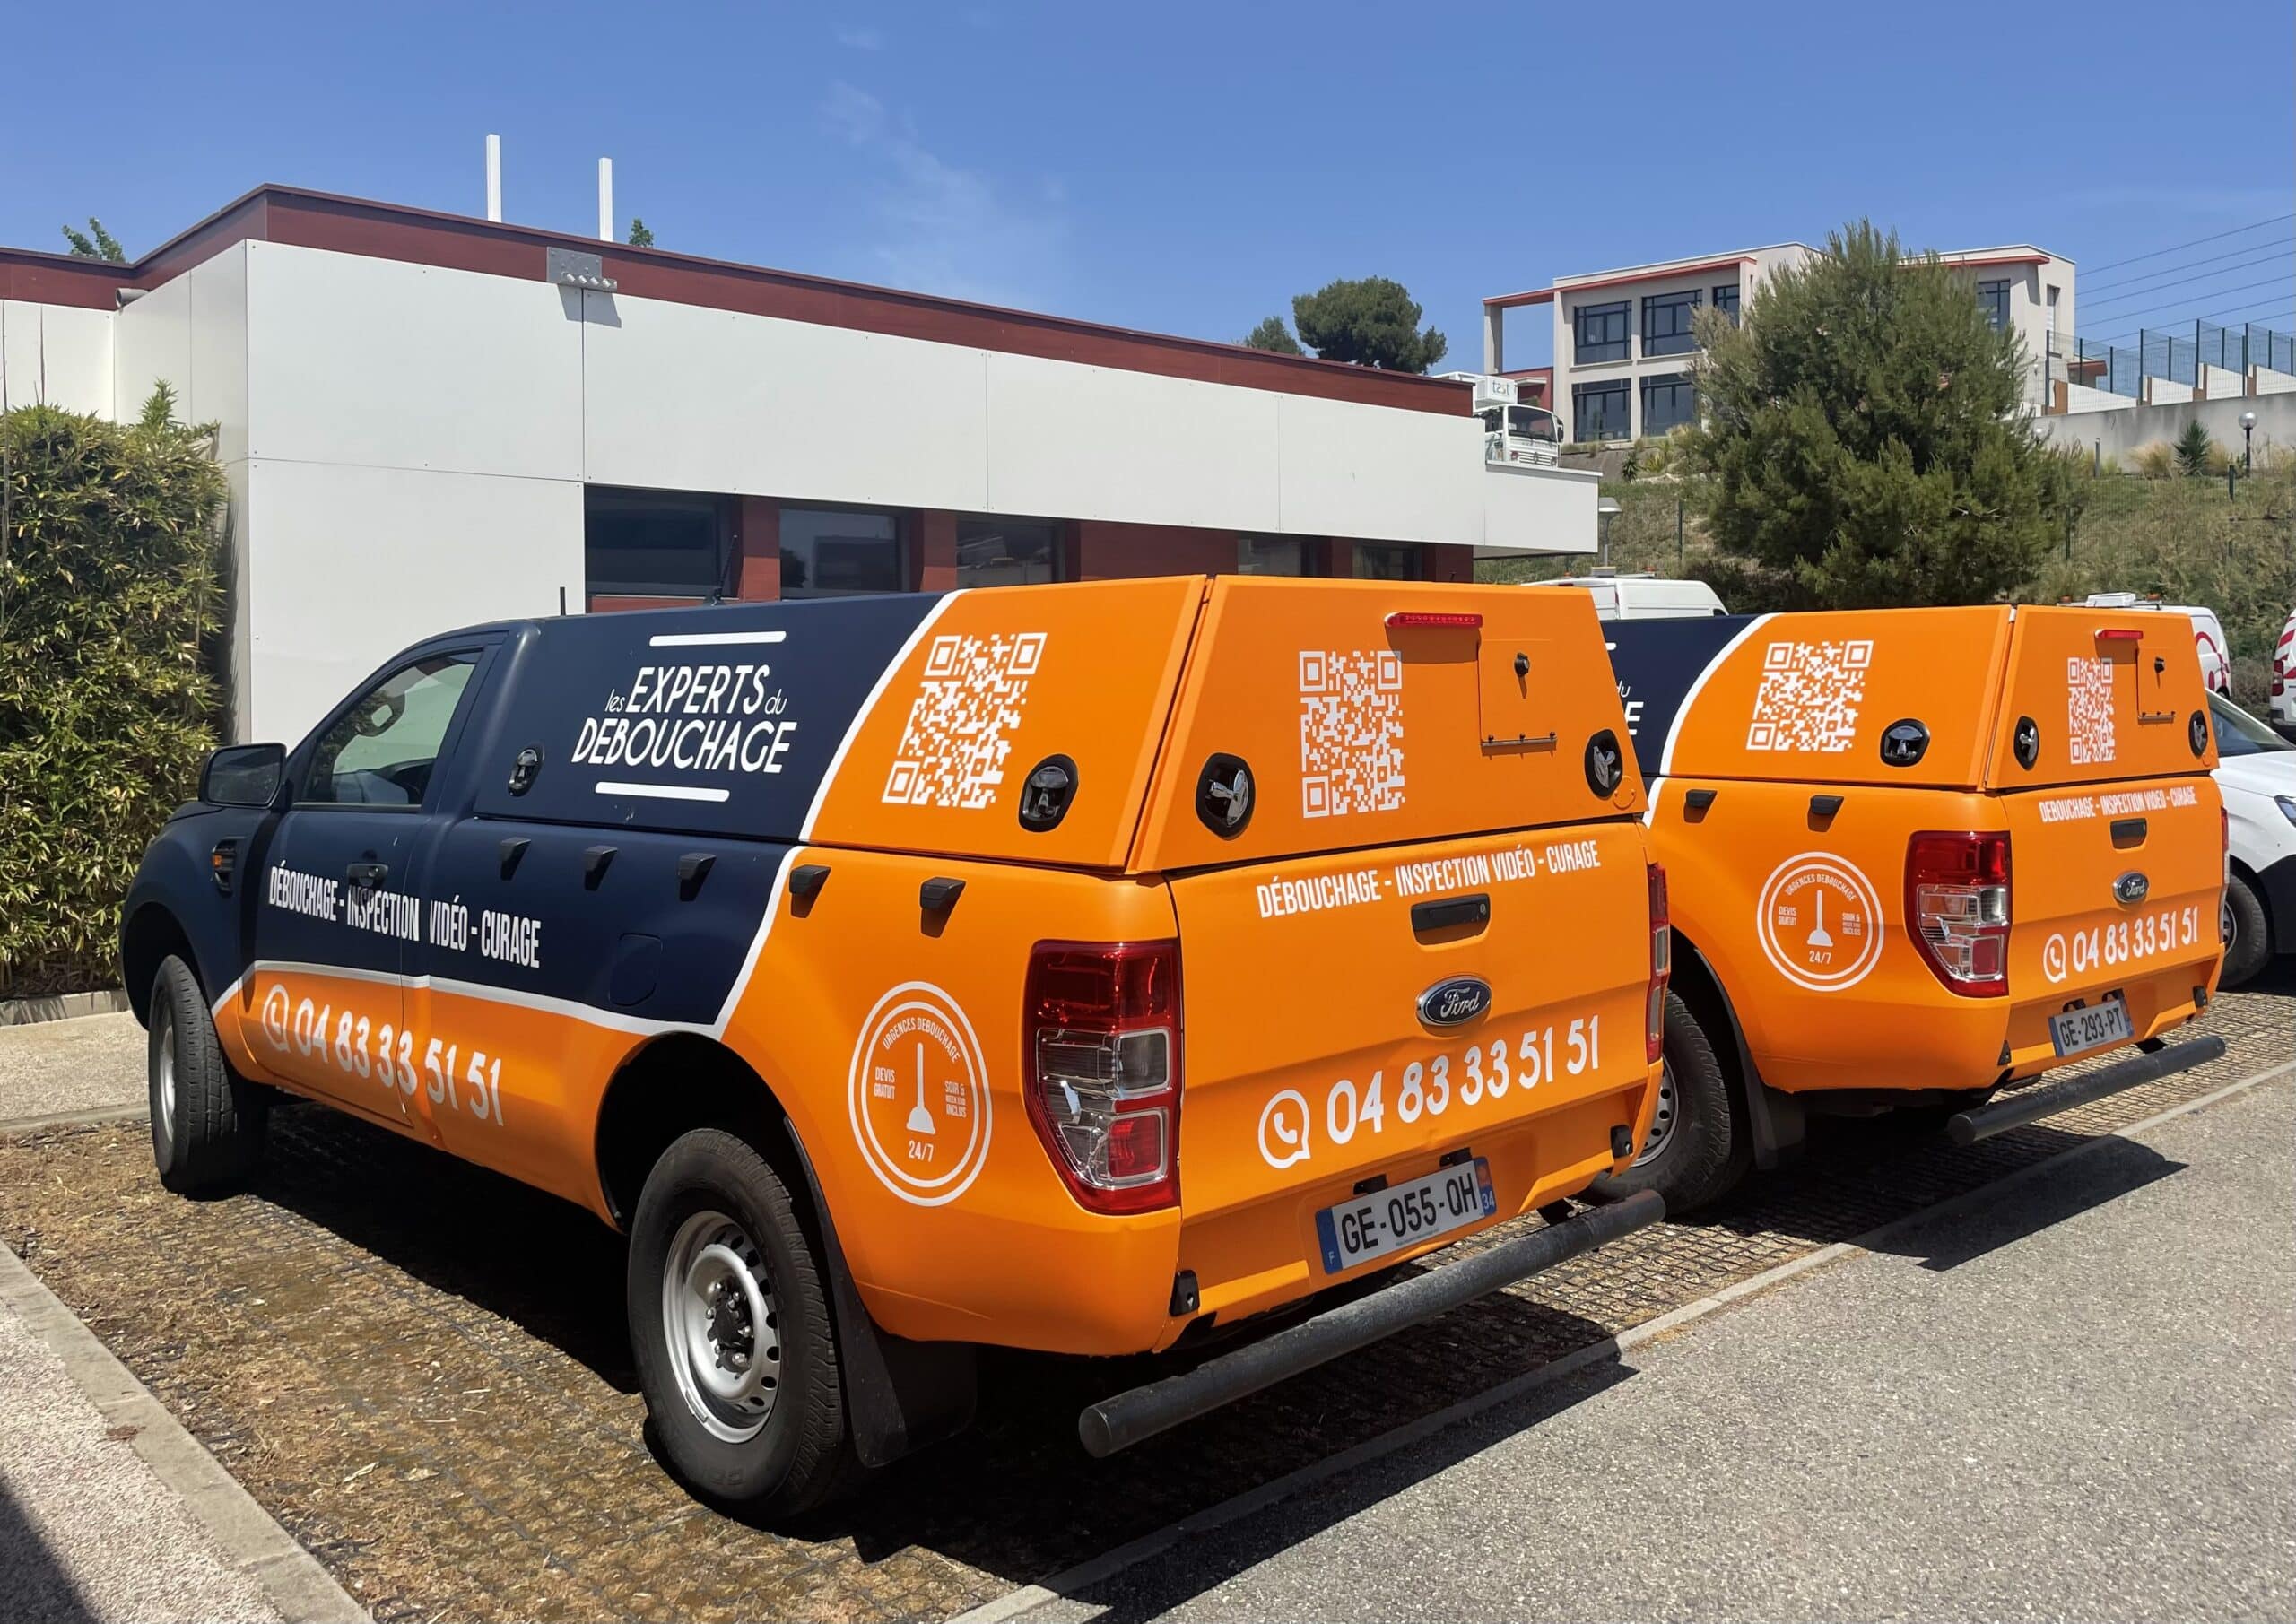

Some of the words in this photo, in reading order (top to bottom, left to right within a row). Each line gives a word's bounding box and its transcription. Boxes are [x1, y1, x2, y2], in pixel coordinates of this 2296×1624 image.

[605, 689, 625, 712] les
[625, 664, 770, 714] EXPERTS
[765, 688, 787, 715] du
[571, 717, 797, 773] DEBOUCHAGE
[2100, 792, 2145, 816] INSPECTION
[1257, 870, 1381, 918] DÉBOUCHAGE
[1395, 854, 1490, 897] INSPECTION
[1492, 844, 1535, 881] VIDÉO
[1546, 839, 1601, 874] CURAGE
[2126, 877, 2146, 897] Ford
[269, 860, 339, 922] DÉBOUCHAGE
[347, 885, 420, 942] INSPECTION
[430, 894, 467, 951] VIDÉO
[481, 910, 542, 968] CURAGE
[1809, 951, 1831, 964] 24/7
[2074, 928, 2099, 972] 04
[2104, 922, 2128, 965] 83
[2133, 916, 2155, 958] 33
[2160, 910, 2177, 951] 51
[2181, 906, 2198, 945] 51
[1440, 987, 1480, 1018] Ford
[883, 1017, 916, 1050] URGENCES
[917, 1017, 960, 1064] DEBOUCHAGE
[2060, 1007, 2123, 1047] GE-293-PT
[294, 998, 330, 1064] 04
[335, 1011, 370, 1079] 83
[377, 1024, 418, 1096] 33
[425, 1038, 459, 1111] 51
[467, 1051, 504, 1126] 51
[874, 1066, 895, 1082] DEVIS
[1326, 1070, 1385, 1144] 04
[1397, 1055, 1450, 1124] 83
[1459, 1038, 1509, 1106] 33
[1518, 1026, 1554, 1090] 51
[1567, 1014, 1599, 1075] 51
[944, 1080, 959, 1094] SOIR
[909, 1140, 935, 1162] 24/7
[1342, 1173, 1478, 1255] GE-055-QH
[1482, 1191, 1494, 1210] 34
[1328, 1251, 1335, 1265] F
